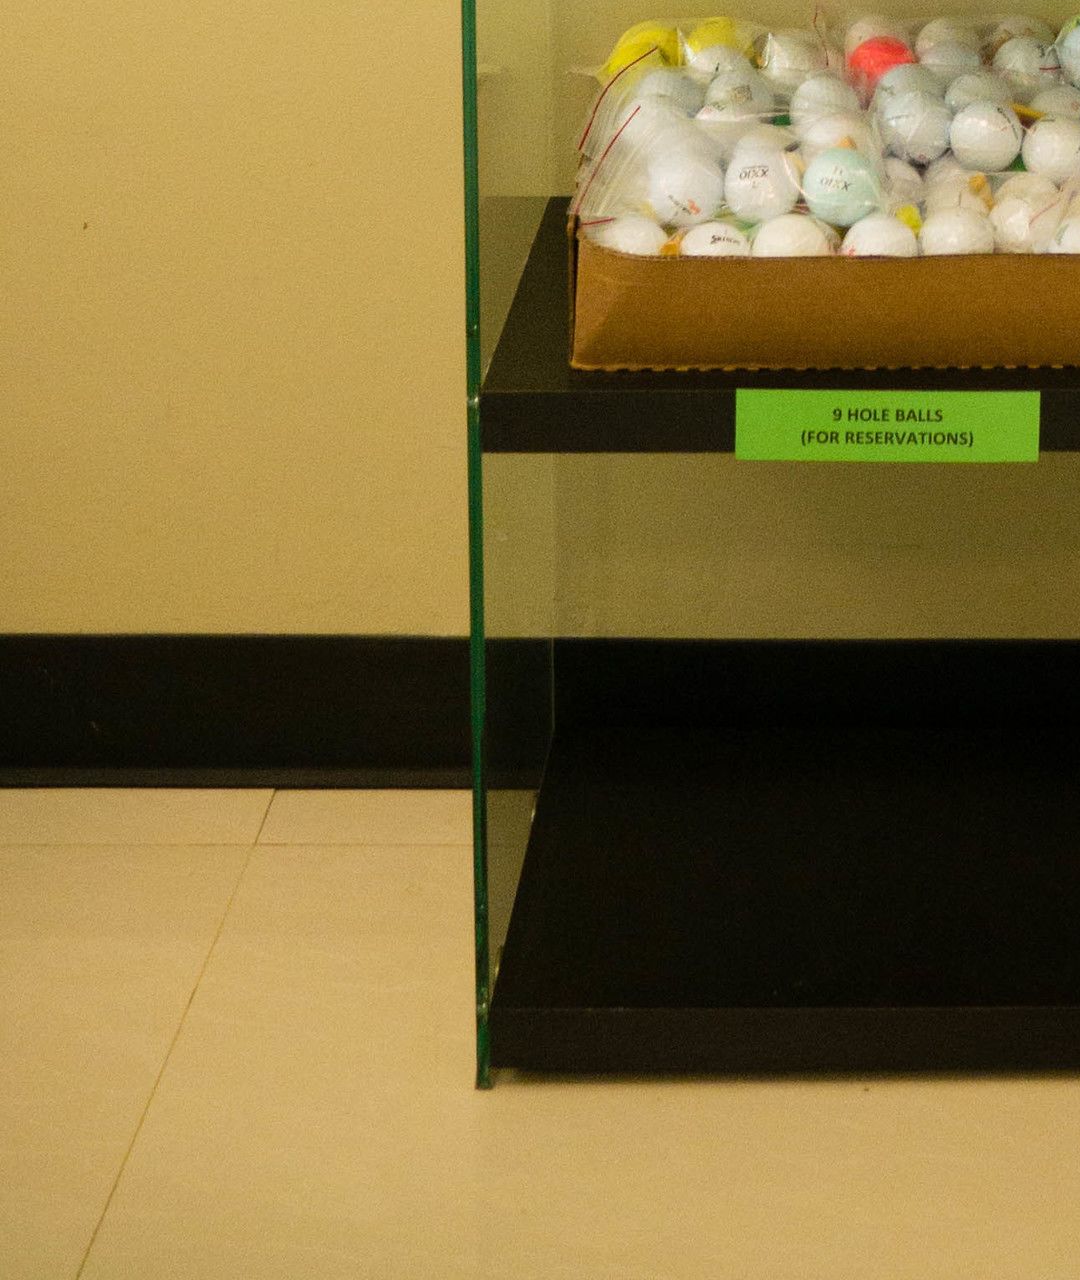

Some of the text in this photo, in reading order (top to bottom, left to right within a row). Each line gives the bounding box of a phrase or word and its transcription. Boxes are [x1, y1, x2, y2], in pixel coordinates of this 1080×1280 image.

[832, 407, 944, 423] 9 HOLE BALLS
[801, 429, 975, 448] (FOR RESERVATIONS)
